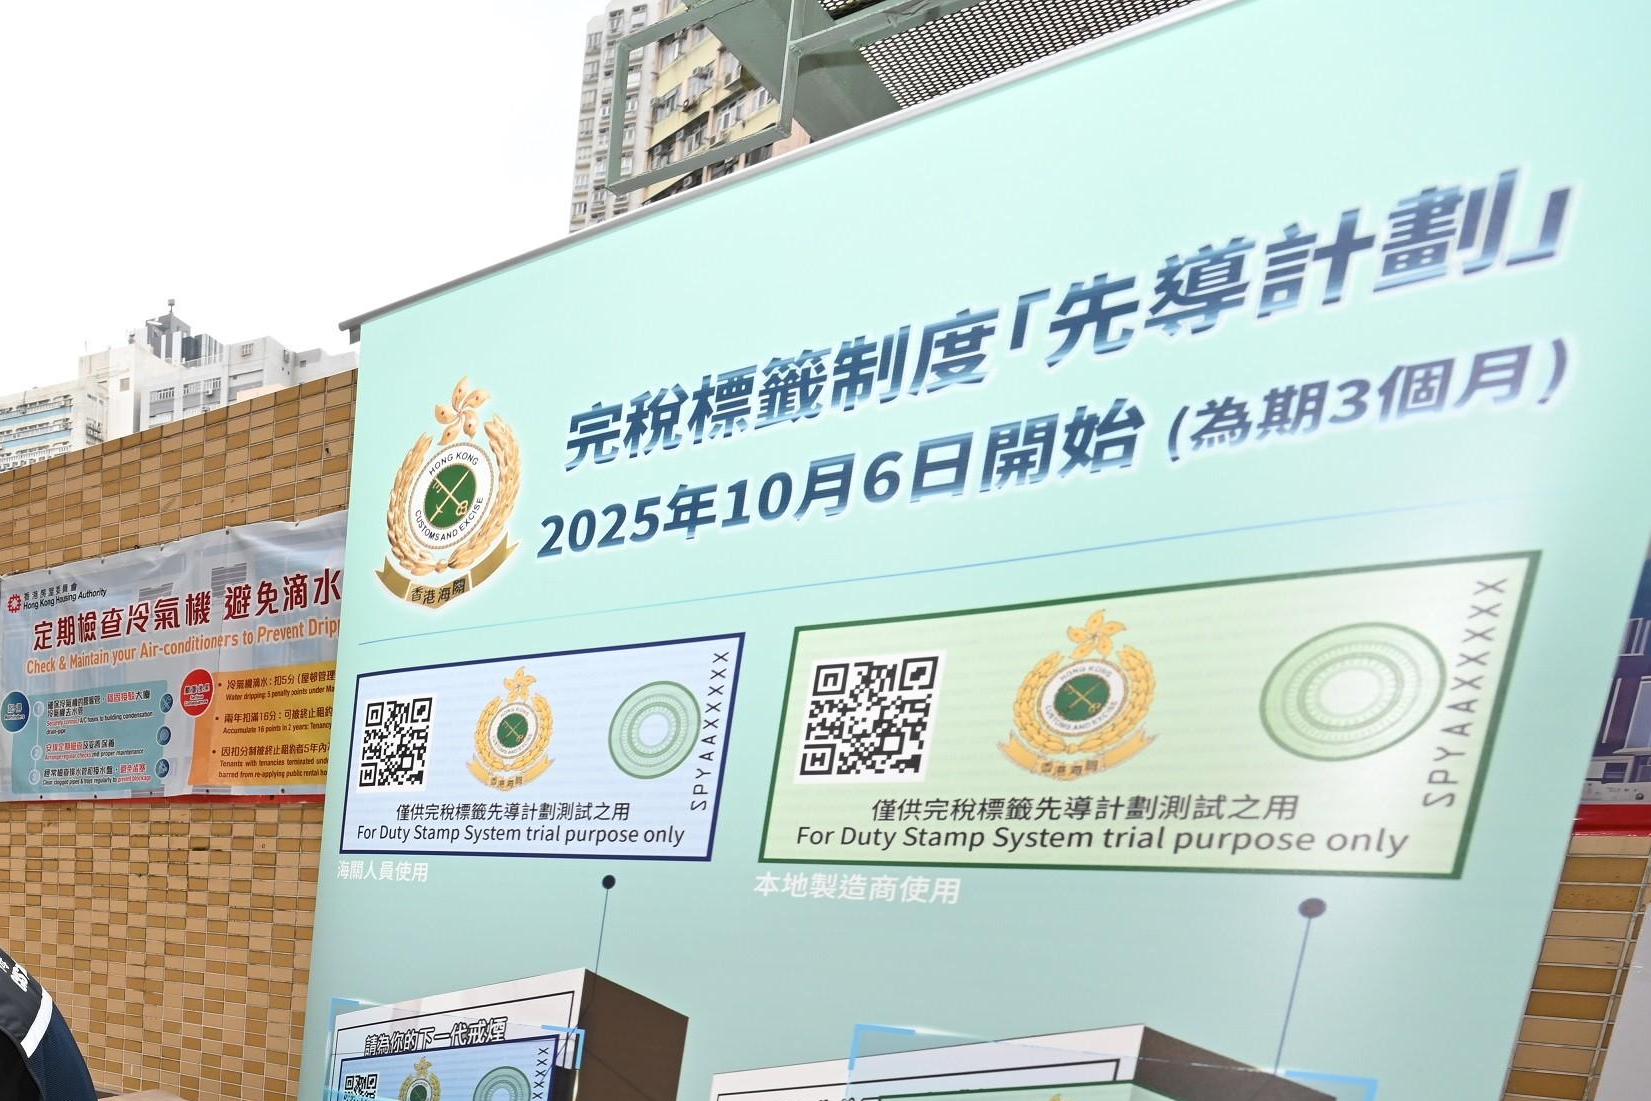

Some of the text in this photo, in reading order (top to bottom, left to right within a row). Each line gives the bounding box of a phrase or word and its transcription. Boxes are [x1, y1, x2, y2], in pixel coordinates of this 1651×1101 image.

[564, 166, 1573, 472] 完稅標籤制度「先導計劃」
[428, 451, 479, 475] HONG KONG
[537, 338, 1568, 558] 2025年10月6日開始 (為期3個月)
[415, 496, 484, 541] CUSTOMS AND EXCISE
[23, 601, 39, 611] Hong
[39, 598, 55, 608] Kong
[78, 588, 107, 600] Authority
[411, 577, 466, 605] 香港海關
[33, 567, 342, 650] 定期檢查冷氣機 避免滴水
[27, 657, 56, 674] Check
[58, 655, 67, 669] &
[70, 652, 109, 669] Maintain
[113, 647, 136, 666] your
[139, 634, 239, 659] Air-conditioners
[242, 630, 253, 645] to
[257, 622, 304, 643] Prevent
[1422, 577, 1507, 808] SPYAAXXXXX
[690, 650, 730, 812] SPYAAXXXXX
[395, 802, 631, 821] 僅供完稅標籤先導計劃測試之用
[871, 793, 1300, 822] 僅供完稅標籤先導計劃測試之用
[357, 825, 685, 848] For Duty Stamp System trial purpose only
[797, 825, 1409, 859] For Duty Stamp System trial purpose only
[337, 860, 429, 882] 海關人員使用
[753, 871, 961, 905] 本地製造商使用
[363, 1016, 508, 1056] 請為你的下一代戒煙
